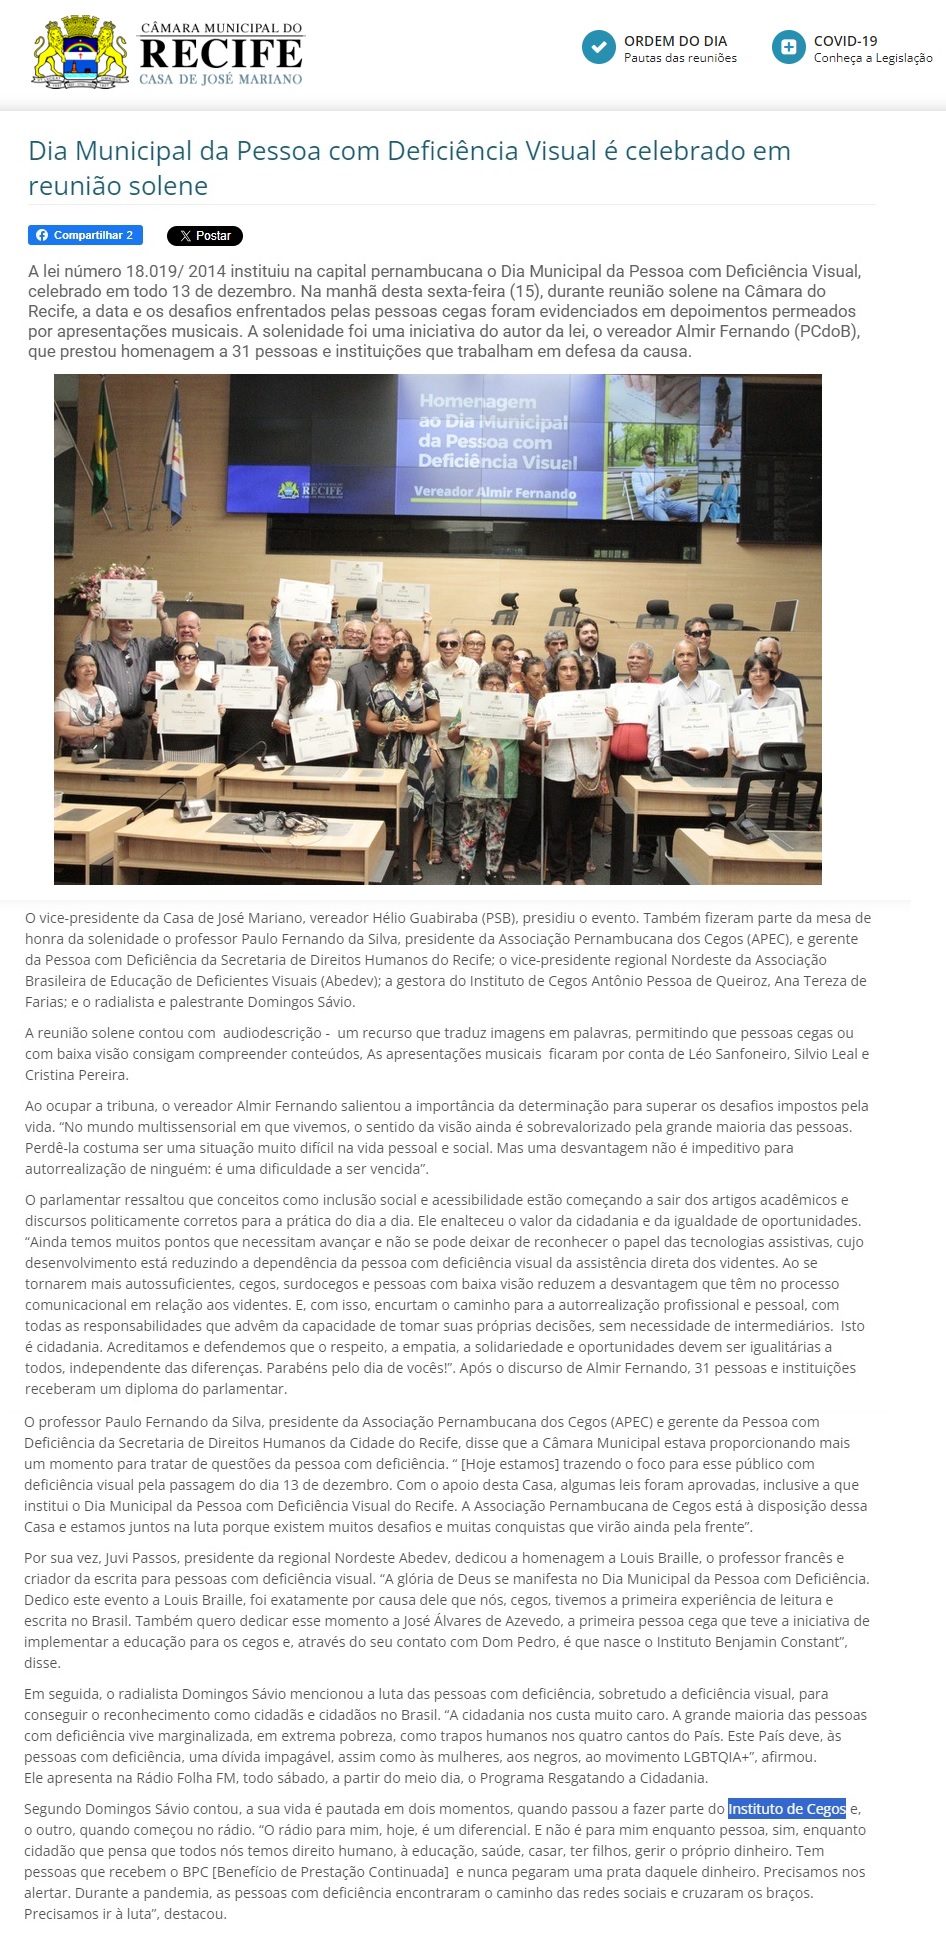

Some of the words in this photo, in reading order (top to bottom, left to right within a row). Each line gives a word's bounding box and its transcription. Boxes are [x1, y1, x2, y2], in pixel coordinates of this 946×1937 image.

[141, 20, 200, 34] CÂMARA
[204, 22, 280, 34] MUNICIPAL
[283, 22, 303, 34] DO
[624, 35, 675, 47] ORDEM
[679, 35, 700, 47] DO
[704, 35, 728, 47] DIA
[813, 35, 878, 47] COVID-19
[139, 38, 303, 69] RECIFE
[624, 52, 662, 63] Pautas
[665, 52, 685, 63] das
[688, 52, 738, 63] reuniões
[813, 52, 863, 66] Conheça
[865, 55, 873, 63] a
[875, 52, 934, 66] Legislação
[139, 73, 174, 85] CASA
[179, 73, 198, 85] DE
[200, 71, 234, 87] JOSÉ
[239, 73, 303, 85] MARIANO
[29, 140, 67, 161] Dia
[76, 139, 191, 167] Municipal
[200, 139, 229, 161] da
[238, 140, 321, 161] Pessoa
[329, 145, 380, 161] com
[388, 139, 518, 161] Deficiência
[525, 139, 596, 161] Visual
[604, 139, 618, 161] é
[625, 139, 746, 161] celebrado
[753, 145, 791, 161] em
[29, 175, 122, 196] reunião
[129, 174, 208, 196] solene
[53, 230, 124, 242] Compartilhar
[126, 230, 133, 240] 2
[196, 230, 232, 241] Postar
[27, 264, 40, 278] A
[43, 263, 60, 278] lei
[64, 264, 122, 278] número
[126, 264, 185, 279] 18.019/
[188, 264, 227, 278] 2014
[230, 263, 290, 278] instituiu
[294, 267, 313, 278] na
[316, 263, 367, 281] capital
[371, 263, 483, 281] pernambucana
[487, 267, 497, 278] o
[501, 263, 525, 278] Dia
[529, 263, 602, 281] Municipal
[606, 263, 625, 278] da
[629, 264, 684, 278] Pessoa
[688, 267, 722, 278] com
[726, 263, 808, 278] Deficiência
[811, 263, 862, 280] Visual,
[28, 283, 102, 298] celebrado
[105, 287, 130, 298] em
[132, 283, 168, 298] todo
[172, 284, 191, 298] 13
[194, 283, 214, 298] de
[217, 283, 296, 298] dezembro.
[301, 284, 322, 298] Na
[326, 283, 377, 298] manhã
[381, 283, 423, 298] desta
[427, 283, 506, 298] sexta-feira
[509, 282, 544, 302] (15),
[547, 283, 605, 298] durante
[608, 283, 665, 298] reunião
[668, 283, 718, 298] solene
[722, 287, 740, 298] na
[744, 284, 803, 298] Câmara
[807, 283, 827, 298] do
[419, 394, 537, 411] Homenagem
[419, 417, 442, 430] ao
[445, 415, 474, 430] Dia
[478, 414, 569, 434] Municipal
[419, 435, 440, 449] da
[445, 435, 508, 449] Pessoa
[512, 437, 552, 450] com
[418, 453, 518, 470] Deficiência
[522, 455, 578, 471] Visual
[302, 486, 343, 496] RECIFE
[414, 486, 474, 498] Vereador
[479, 486, 512, 499] Almir
[515, 487, 577, 500] Fernando
[25, 996, 68, 1009] Farias;
[71, 998, 79, 1008] e
[82, 998, 91, 1008] o
[94, 995, 155, 1008] radialista
[158, 998, 166, 1008] e
[169, 995, 244, 1011] palestrante
[248, 996, 315, 1011] Domingos
[317, 995, 356, 1008] Sávio.
[25, 1069, 75, 1081] Cristina
[78, 1069, 129, 1081] Pereira.
[24, 1162, 127, 1178] autorrealização
[129, 1162, 147, 1175] de
[150, 1162, 211, 1178] ninguém:
[215, 1162, 223, 1175] é
[226, 1165, 256, 1175] uma
[259, 1162, 332, 1175] dificuldade
[334, 1165, 343, 1175] a
[346, 1165, 368, 1175] ser
[369, 1162, 429, 1175] vencida”.
[25, 1382, 96, 1395] receberam
[100, 1385, 121, 1395] um
[124, 1382, 178, 1398] diploma
[181, 1382, 199, 1395] do
[202, 1382, 288, 1398] parlamentar.
[24, 1436, 95, 1449] Deficiência
[98, 1436, 115, 1449] da
[118, 1437, 184, 1449] Secretaria
[187, 1436, 205, 1449] de
[208, 1437, 260, 1449] Direitos
[263, 1437, 326, 1449] Humanos
[329, 1436, 346, 1449] da
[349, 1436, 395, 1449] Cidade
[398, 1436, 416, 1449] do
[419, 1436, 462, 1450] Recife,
[465, 1436, 499, 1449] disse
[502, 1439, 528, 1452] que
[530, 1439, 539, 1449] a
[542, 1436, 593, 1449] Câmara
[597, 1436, 660, 1452] Municipal
[664, 1437, 706, 1449] estava
[709, 1436, 816, 1452] proporcionando
[819, 1437, 851, 1449] mais
[24, 1656, 61, 1669] disse.
[24, 1802, 82, 1818] Segundo
[85, 1803, 152, 1818] Domingos
[155, 1802, 190, 1815] Sávio
[193, 1803, 242, 1816] contou,
[246, 1805, 254, 1815] a
[257, 1805, 280, 1815] sua
[283, 1802, 311, 1815] vida
[314, 1802, 323, 1815] é
[326, 1802, 380, 1818] pautada
[383, 1805, 405, 1815] em
[408, 1802, 436, 1815] dois
[439, 1803, 514, 1816] momentos,
[517, 1802, 568, 1818] quando
[571, 1805, 618, 1818] passou
[621, 1805, 629, 1815] a
[632, 1802, 667, 1815] fazer
[669, 1803, 705, 1818] parte
[708, 1802, 725, 1815] do
[729, 1802, 784, 1815] Instituto
[786, 1802, 804, 1815] de
[806, 1803, 846, 1817] Cegos
[850, 1805, 862, 1816] e,
[24, 1908, 99, 1920] Precisamos
[102, 1908, 113, 1920] ir
[115, 1907, 123, 1920] à
[127, 1907, 160, 1921] luta”,
[163, 1907, 227, 1920] destacou.
